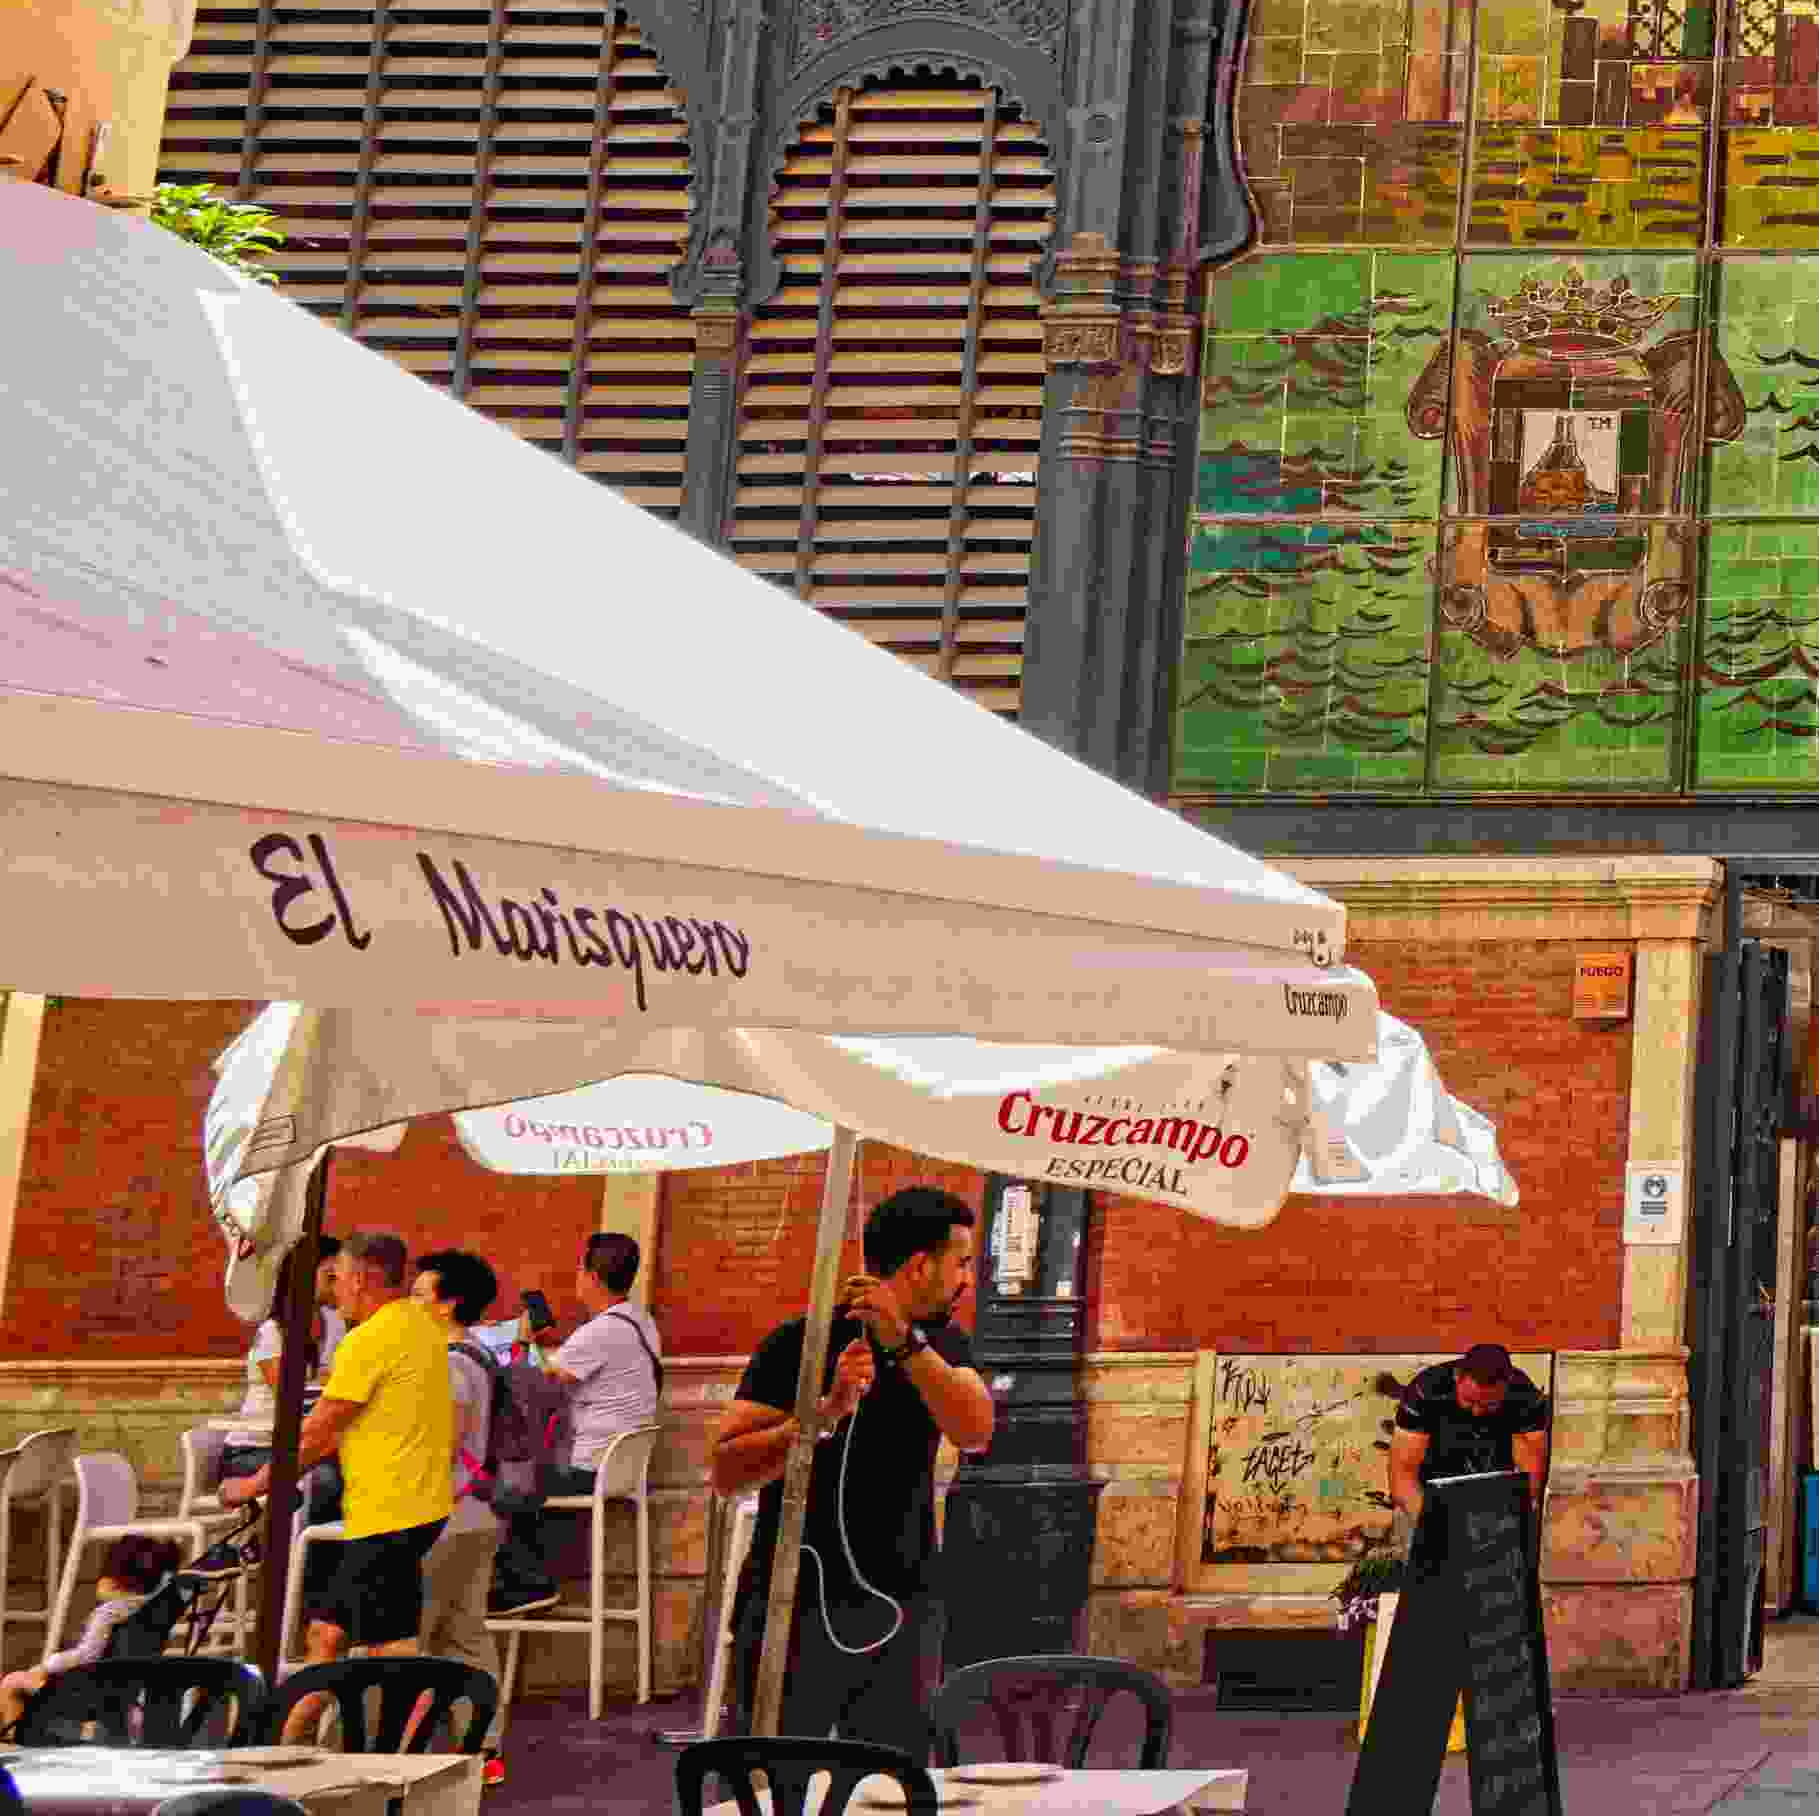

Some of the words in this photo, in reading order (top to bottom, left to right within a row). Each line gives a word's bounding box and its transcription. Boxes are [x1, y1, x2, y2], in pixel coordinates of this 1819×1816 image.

[250, 832, 371, 950] El
[416, 851, 751, 1012] Marisquero
[1283, 983, 1348, 1024] Cruzcampo
[998, 1088, 1249, 1169] Cruzcampo
[1045, 1157, 1189, 1196] ESPECIAL
